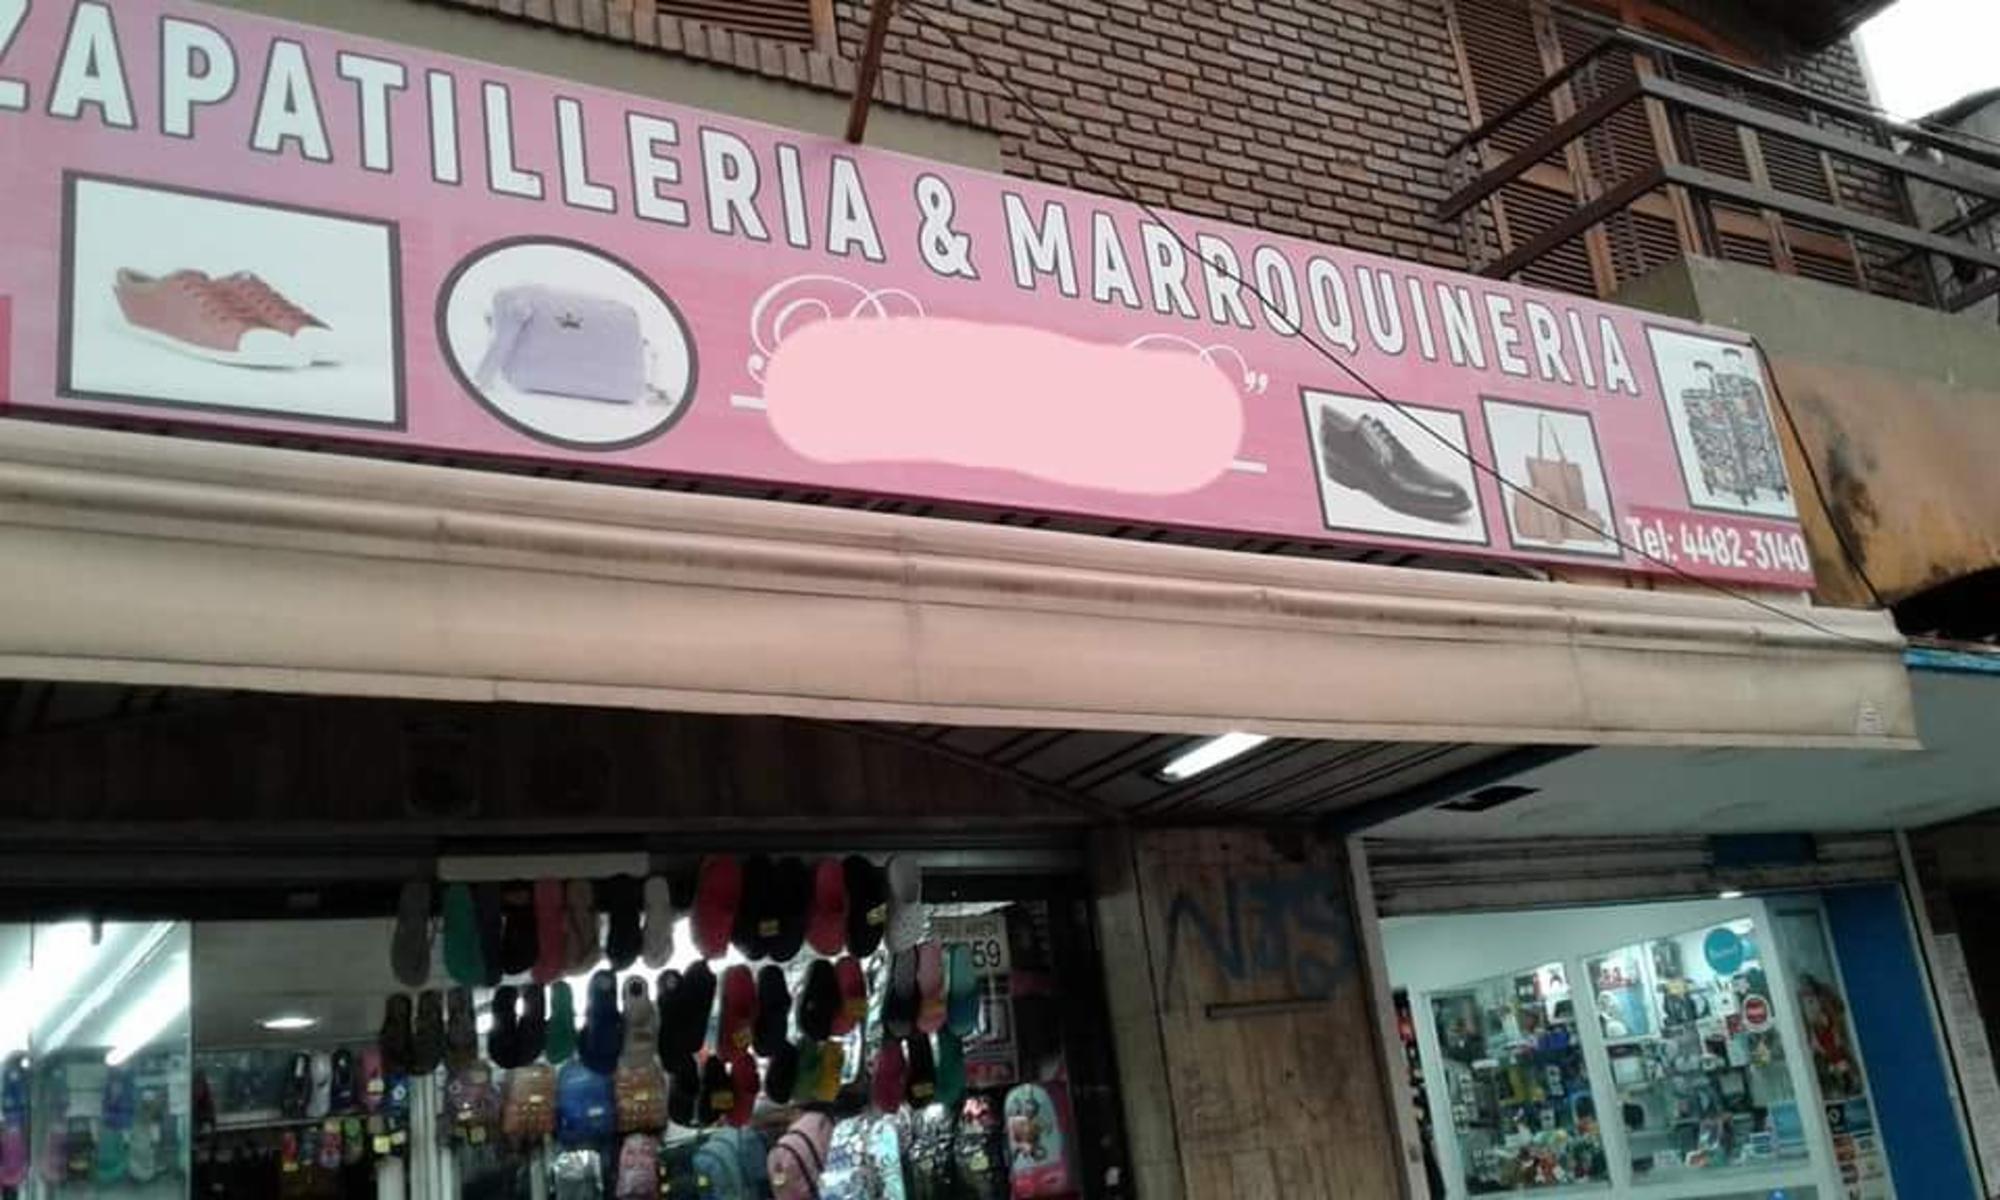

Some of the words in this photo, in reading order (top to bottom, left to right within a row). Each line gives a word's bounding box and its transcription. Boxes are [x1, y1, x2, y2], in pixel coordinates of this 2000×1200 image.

[914, 172, 981, 280] &
[1003, 191, 1640, 397] MARROQUINERIA
[1624, 516, 1679, 563] Tel:
[1679, 522, 1810, 573] 4482-3140
